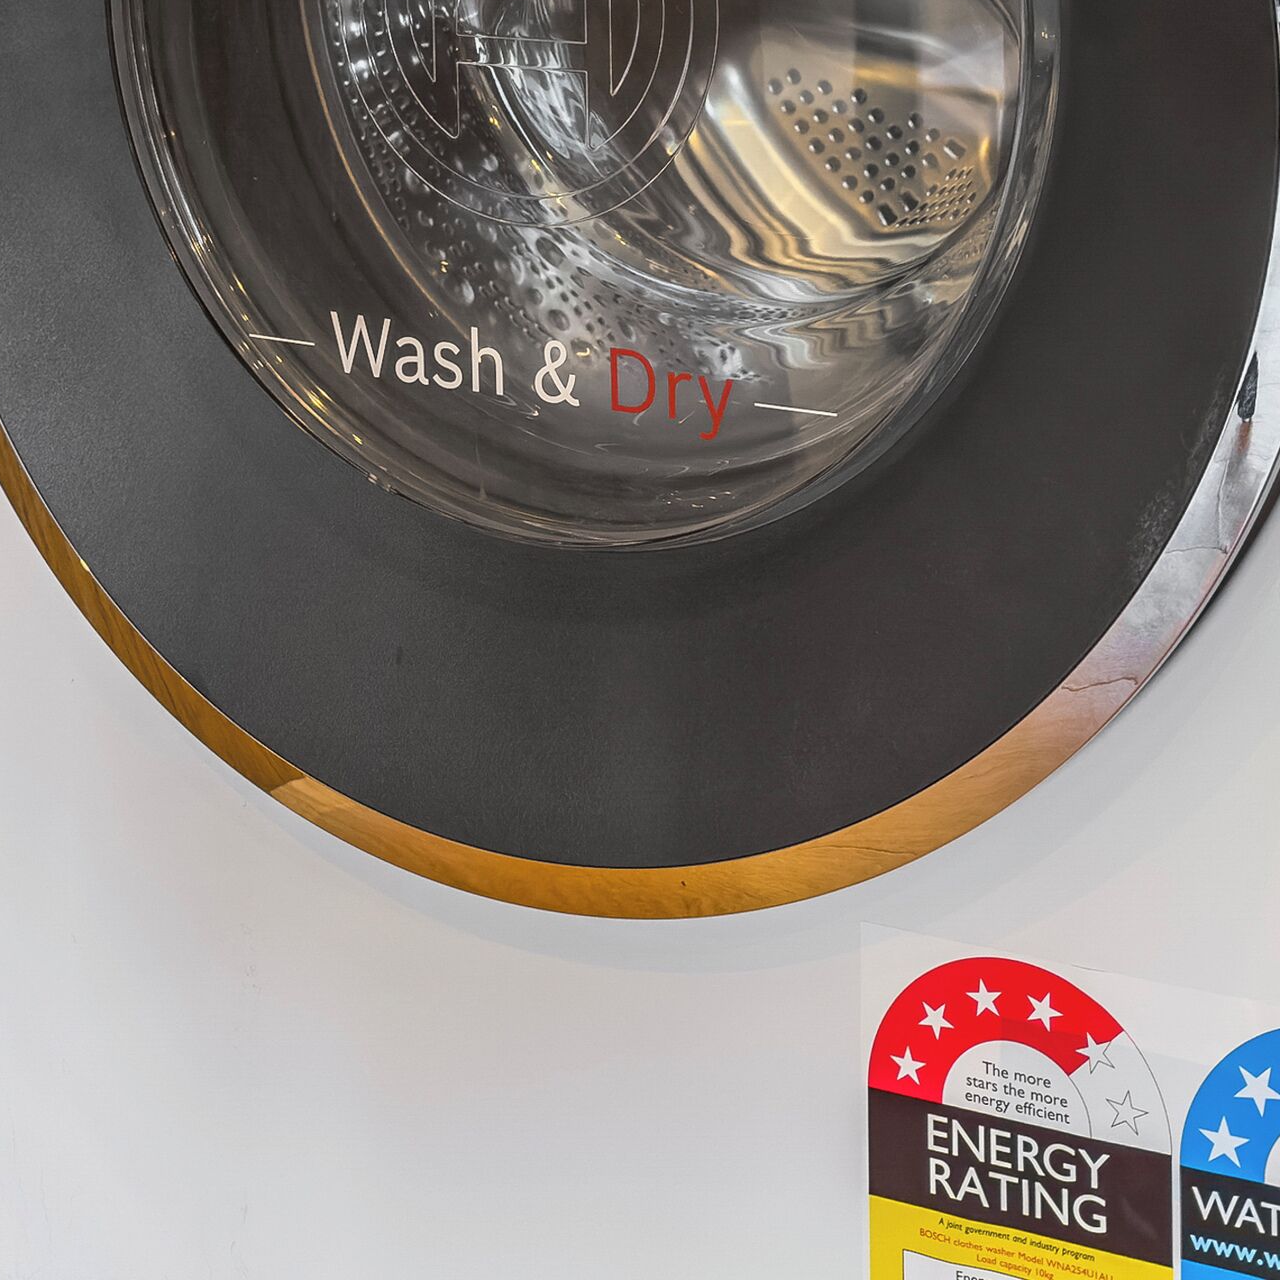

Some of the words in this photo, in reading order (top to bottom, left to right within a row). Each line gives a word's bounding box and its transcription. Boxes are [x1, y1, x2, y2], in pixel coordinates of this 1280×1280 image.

[329, 310, 505, 396] Wash
[533, 340, 581, 408] &
[609, 347, 734, 440] Dry
[965, 1075, 998, 1093] stars
[1003, 1082, 1025, 1099] the
[1030, 1090, 1068, 1109] more
[982, 1060, 1009, 1080] The
[1014, 1071, 1052, 1089] more
[964, 1091, 1010, 1113] energy
[1015, 1102, 1071, 1125] efficient
[926, 1113, 1111, 1190] ENERGY
[929, 1156, 1108, 1234] RATING
[920, 1227, 951, 1244] BOSCH
[953, 1238, 983, 1251] clothes
[985, 1245, 1015, 1258] washer
[1018, 1251, 1044, 1265] Model
[938, 1217, 945, 1226] A
[946, 1220, 963, 1231] joint
[965, 1226, 1010, 1241] government
[1012, 1235, 1027, 1245] and
[1030, 1238, 1059, 1255] industry
[1062, 1247, 1095, 1261] program
[976, 1254, 997, 1265] Load
[1000, 1259, 1032, 1276] capacity
